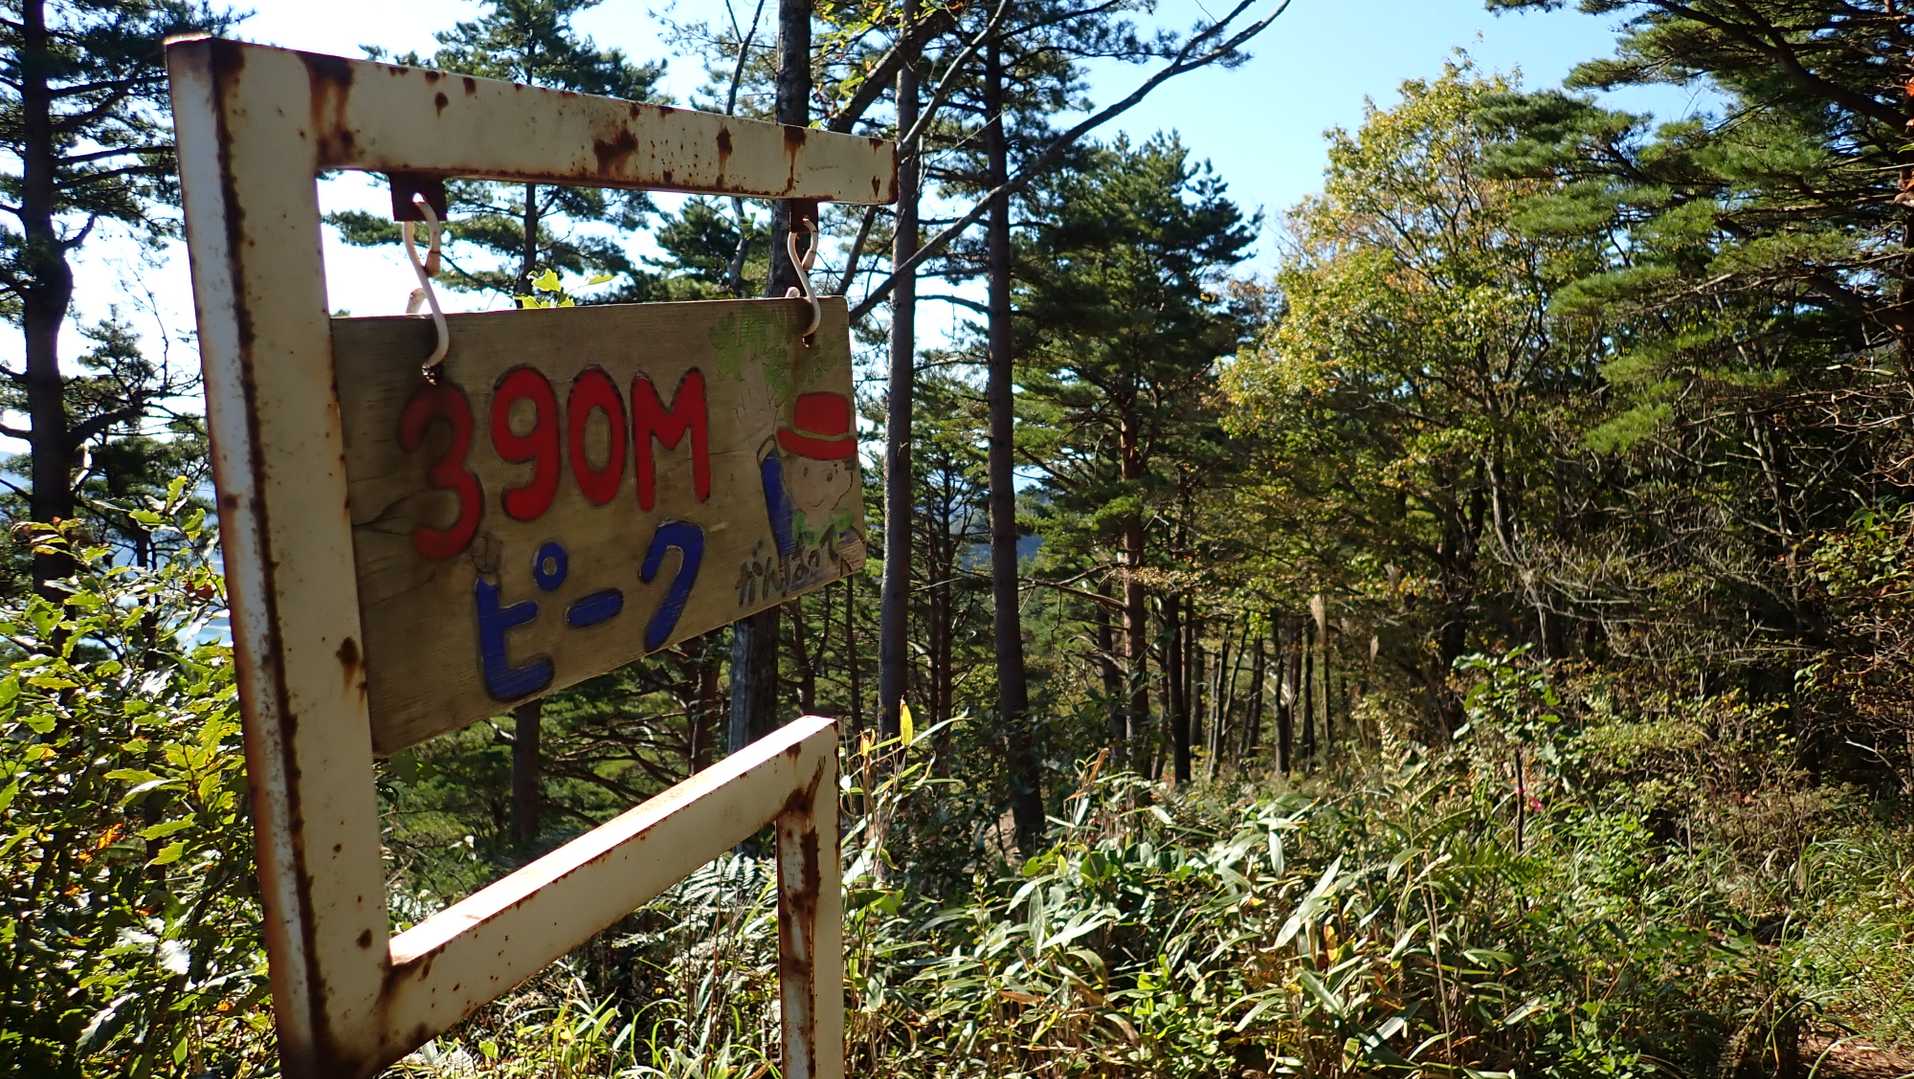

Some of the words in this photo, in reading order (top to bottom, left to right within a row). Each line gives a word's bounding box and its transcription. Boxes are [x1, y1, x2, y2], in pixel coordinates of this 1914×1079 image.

[402, 365, 711, 560] 390M
[475, 519, 705, 699] ピーク
